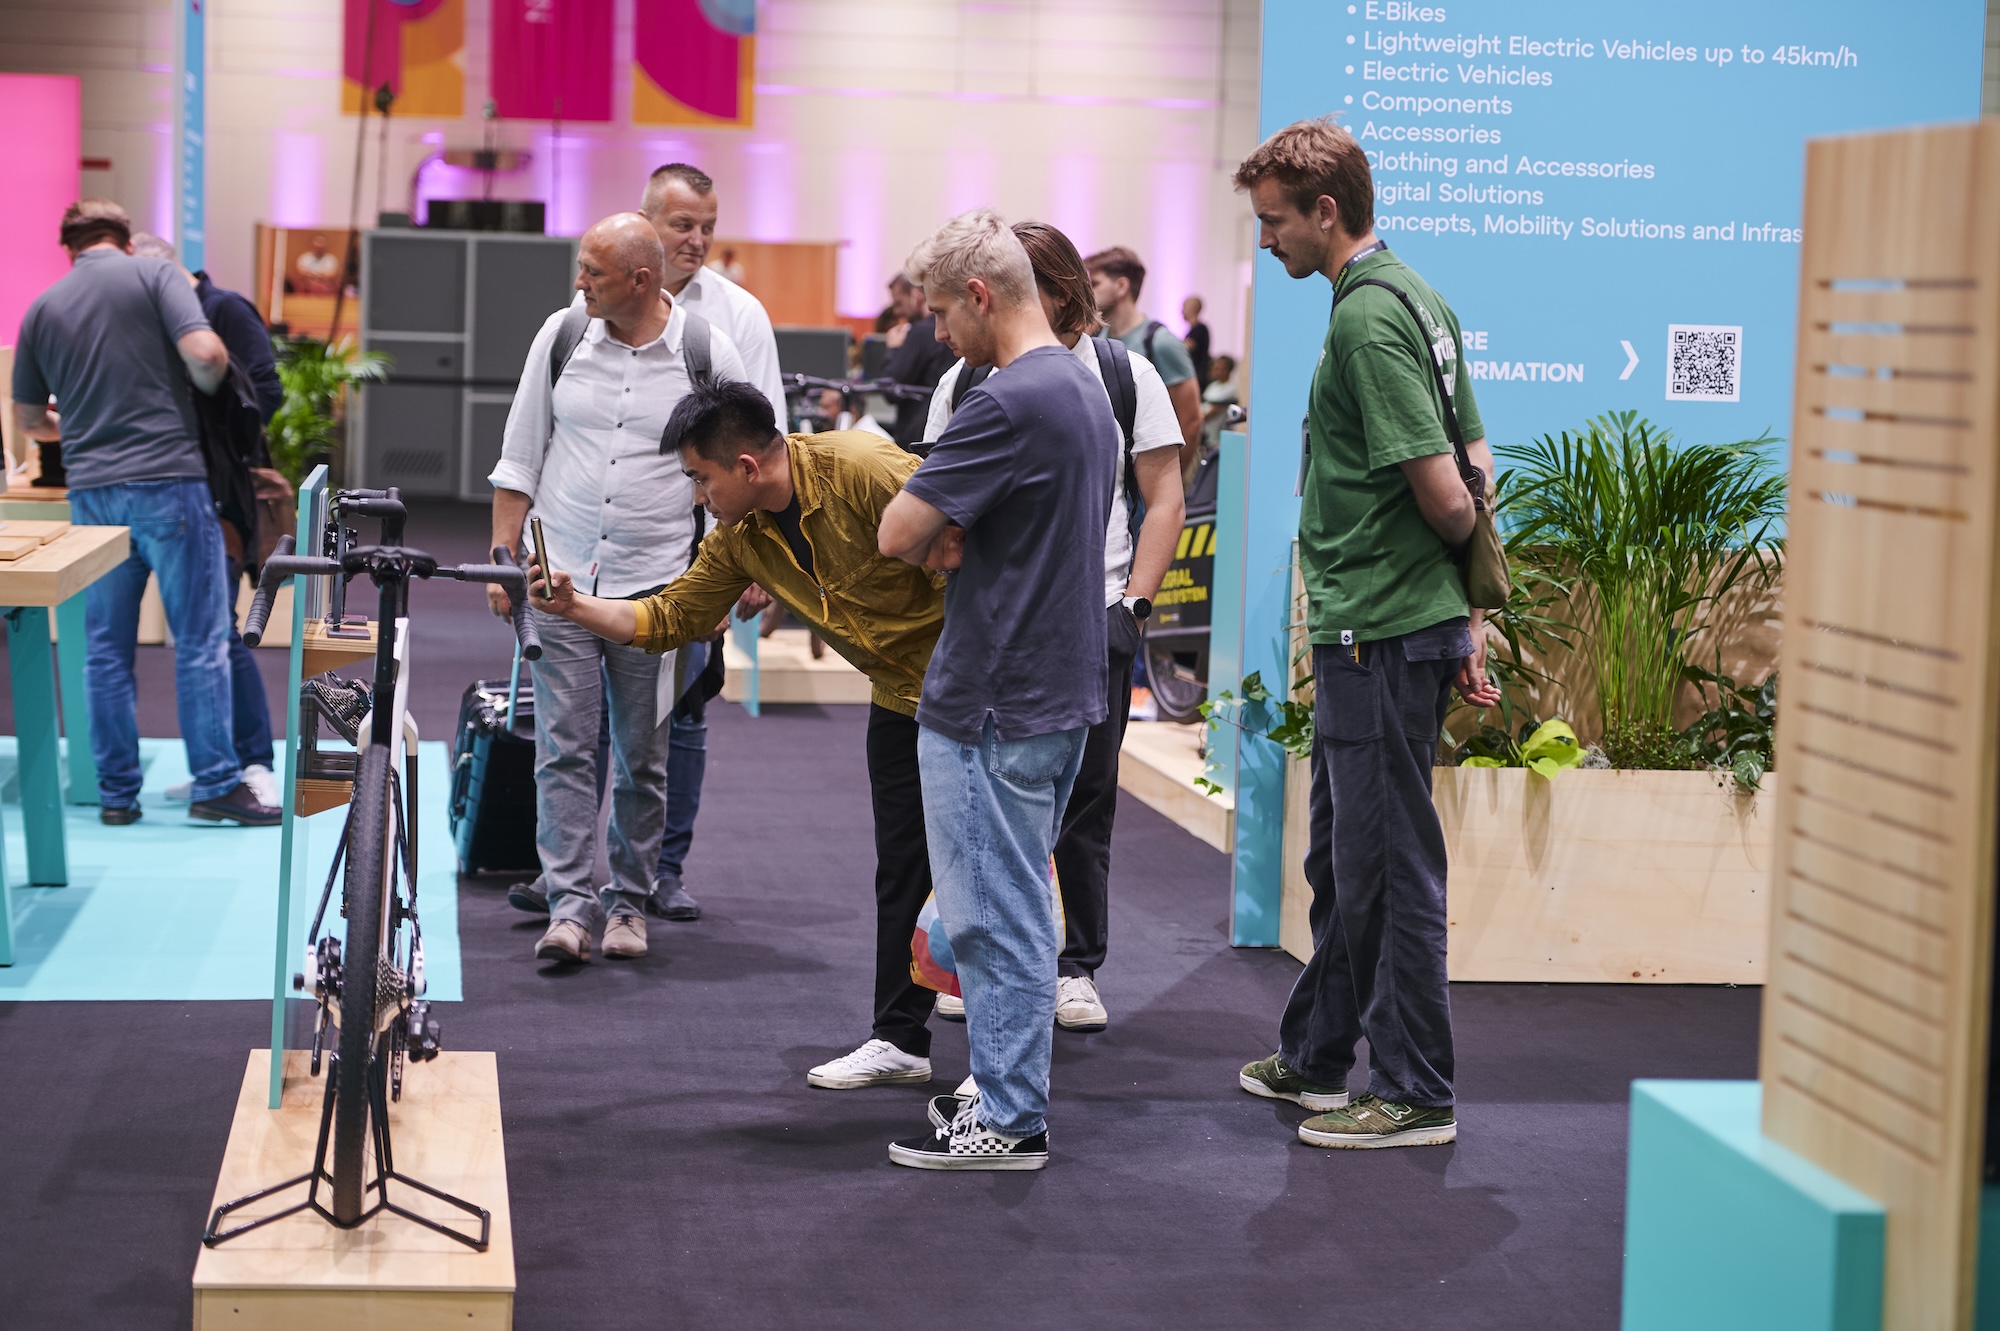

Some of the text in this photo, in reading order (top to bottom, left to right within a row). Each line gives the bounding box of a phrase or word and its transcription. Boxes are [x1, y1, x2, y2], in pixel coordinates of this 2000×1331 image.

[1365, 0, 1446, 23] E-Bikes
[1364, 31, 1858, 69] Lightweight Electric Vehicles up to 45km/h
[1363, 60, 1553, 87] Electric Vehicles
[1362, 90, 1513, 117] Components
[1361, 120, 1502, 144] Accessories
[1465, 154, 1508, 175] and
[1515, 155, 1655, 180] Accessories
[1373, 180, 1544, 206] igital Solutions
[1373, 212, 1477, 236] oncepts,
[1484, 214, 1574, 240] Mobility
[1581, 216, 1686, 240] Solutions
[1692, 220, 1735, 241] and
